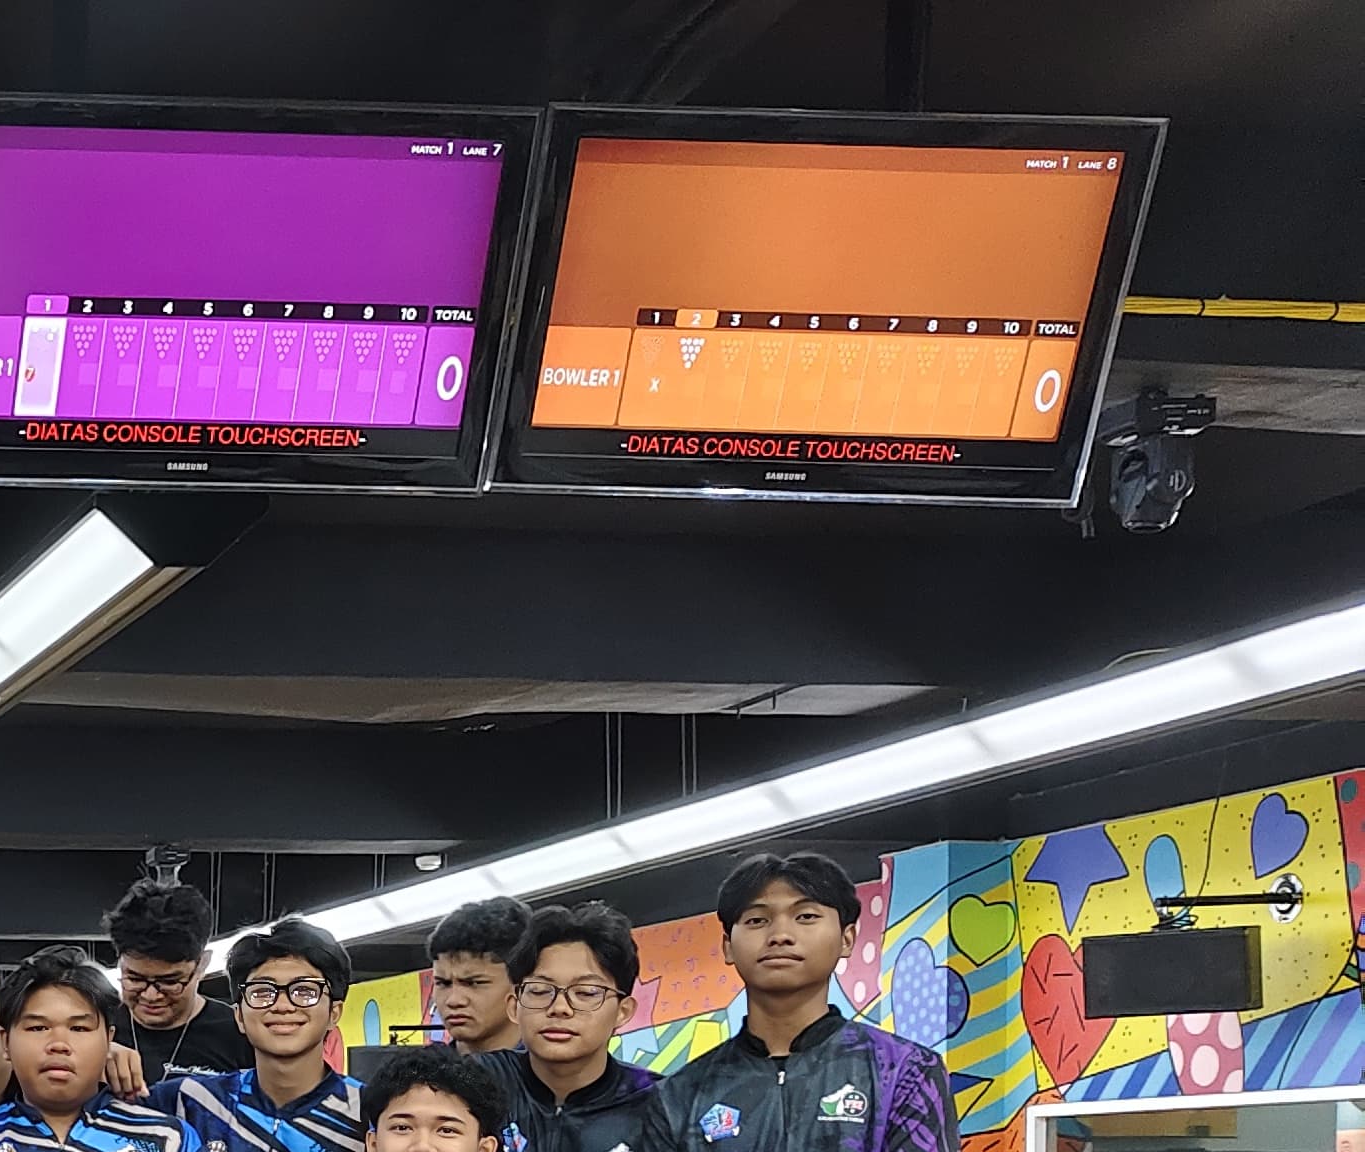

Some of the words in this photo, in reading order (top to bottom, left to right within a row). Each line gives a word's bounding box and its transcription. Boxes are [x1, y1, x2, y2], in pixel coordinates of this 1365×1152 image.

[411, 145, 442, 155] MATCH
[447, 141, 454, 155] 1
[462, 146, 488, 156] LANE
[492, 143, 503, 156] 7
[1026, 159, 1057, 169] MATCH
[1062, 156, 1069, 169] 1
[1077, 161, 1103, 170] LANE
[1106, 157, 1118, 170] 8
[43, 299, 51, 311] 1
[82, 300, 93, 313] 2
[122, 301, 133, 314] 3
[163, 302, 173, 314] 4
[203, 302, 214, 316] 5
[242, 304, 253, 316] 6
[283, 304, 294, 317] 7
[323, 305, 334, 318] 8
[363, 306, 374, 319] 9
[400, 307, 417, 321] 10
[434, 309, 474, 322] TOTAL
[652, 312, 660, 324] 1
[691, 313, 702, 325] 2
[730, 314, 741, 326] 3
[769, 315, 781, 328] 4
[809, 316, 820, 328] 5
[848, 317, 859, 330] 6
[888, 318, 899, 330] 7
[927, 319, 938, 332] 8
[967, 320, 978, 333] 9
[1003, 321, 1020, 334] 10
[1037, 323, 1077, 336] TOTAL
[5, 356, 14, 377] 1
[436, 355, 464, 401] 0
[542, 367, 610, 387] BOWLER
[611, 369, 621, 387] 1
[1034, 369, 1063, 413] 0
[102, 424, 202, 444] CONSOLE
[703, 438, 800, 458] CONSOLE
[166, 462, 208, 471] SAMSUNG
[765, 472, 806, 481] SAMSUNG
